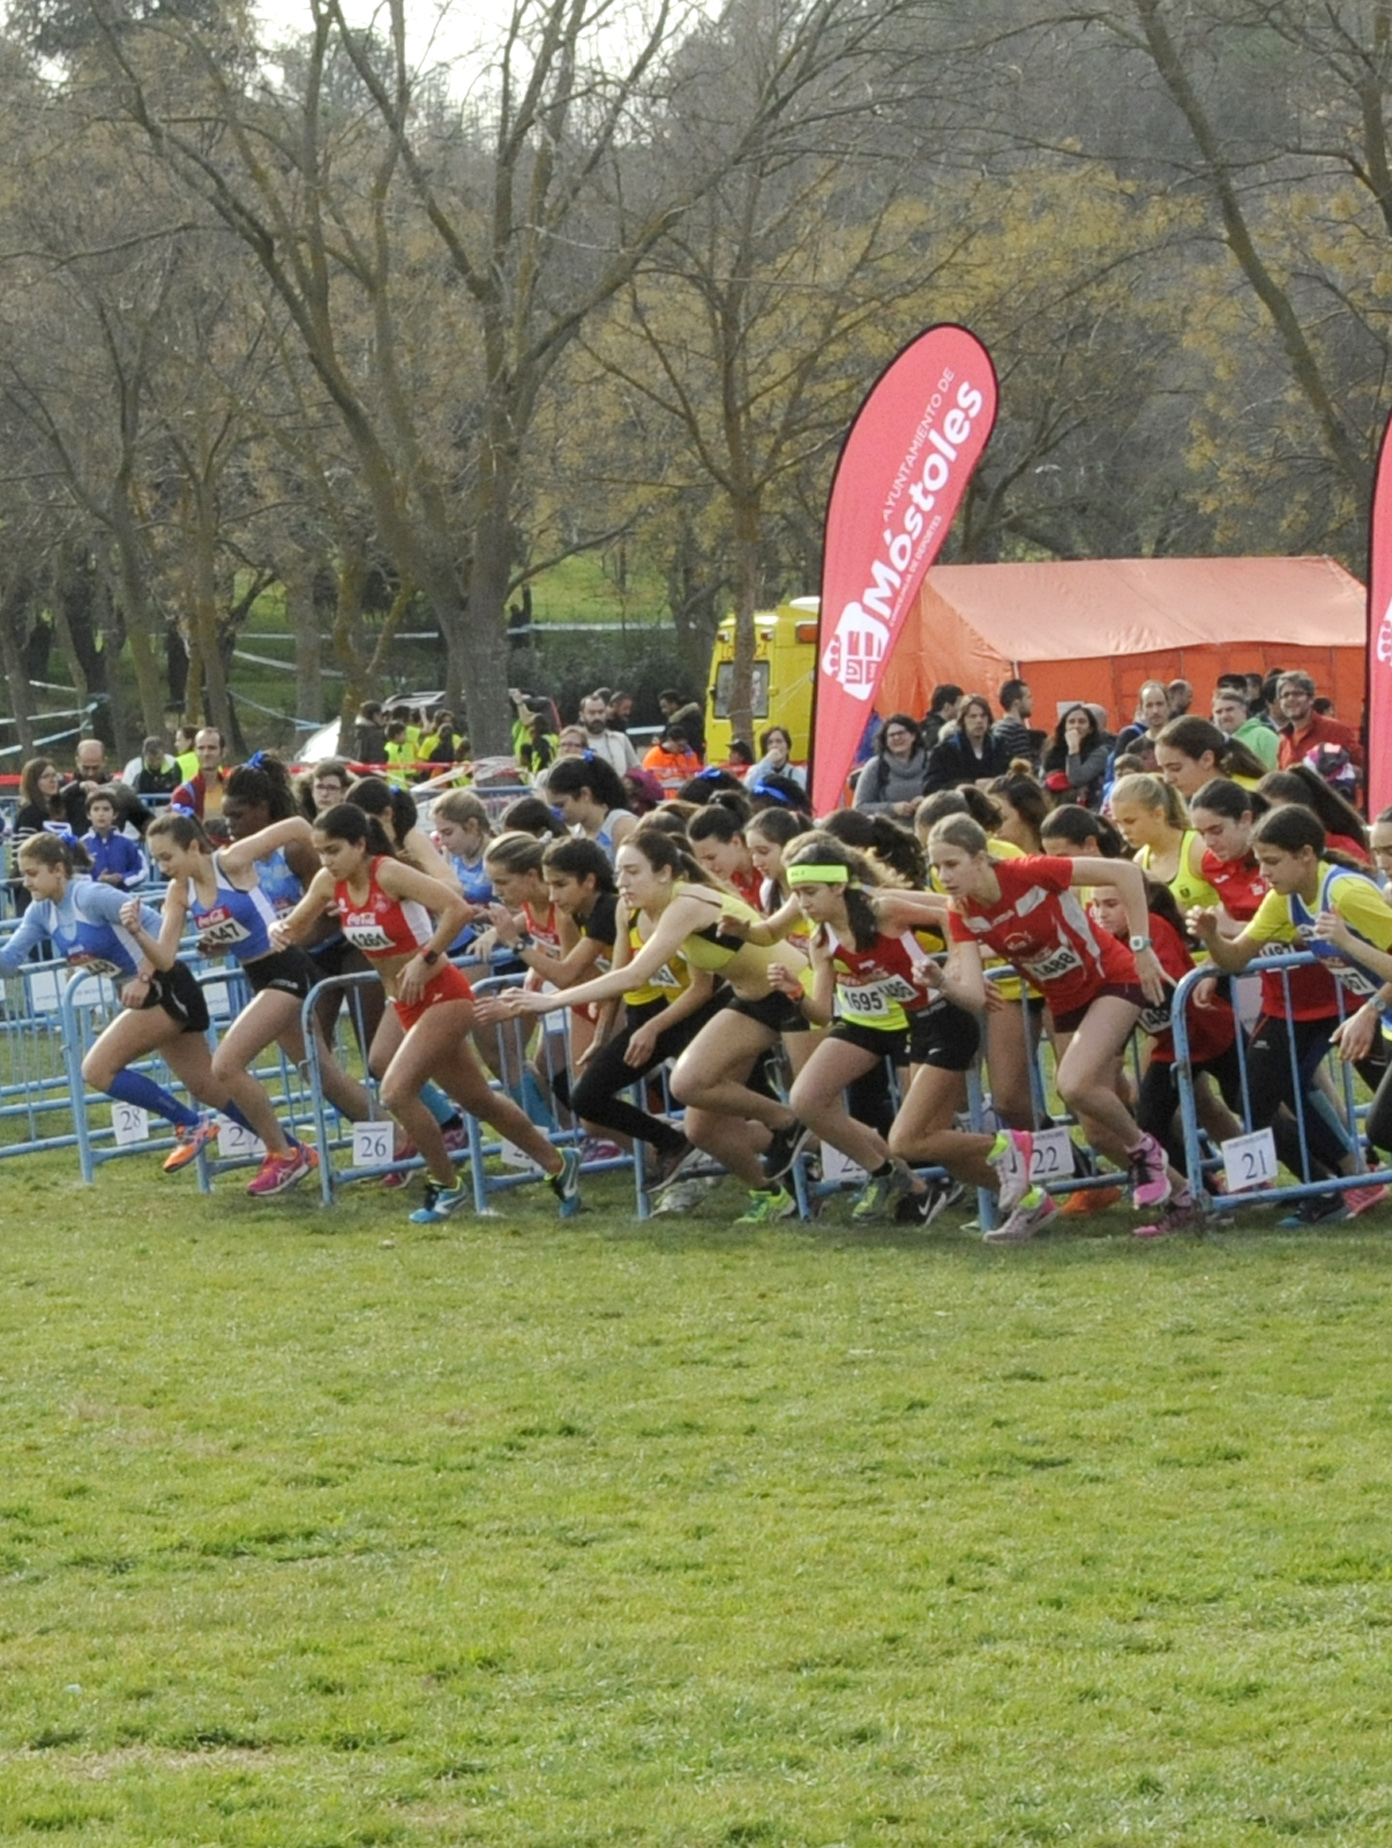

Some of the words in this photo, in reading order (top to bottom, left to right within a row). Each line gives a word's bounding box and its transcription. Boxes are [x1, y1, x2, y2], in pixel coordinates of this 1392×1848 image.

[882, 392, 942, 523] AYUNTAMIENTO
[937, 366, 956, 393] DE
[862, 380, 983, 620] Móstoles
[351, 932, 391, 948] 1261
[1032, 952, 1076, 976] 1488
[844, 991, 883, 1012] 1695
[120, 1108, 142, 1132] 28
[360, 1136, 387, 1158] 26
[1032, 1146, 1059, 1174] 22
[1242, 1149, 1268, 1180] 21
